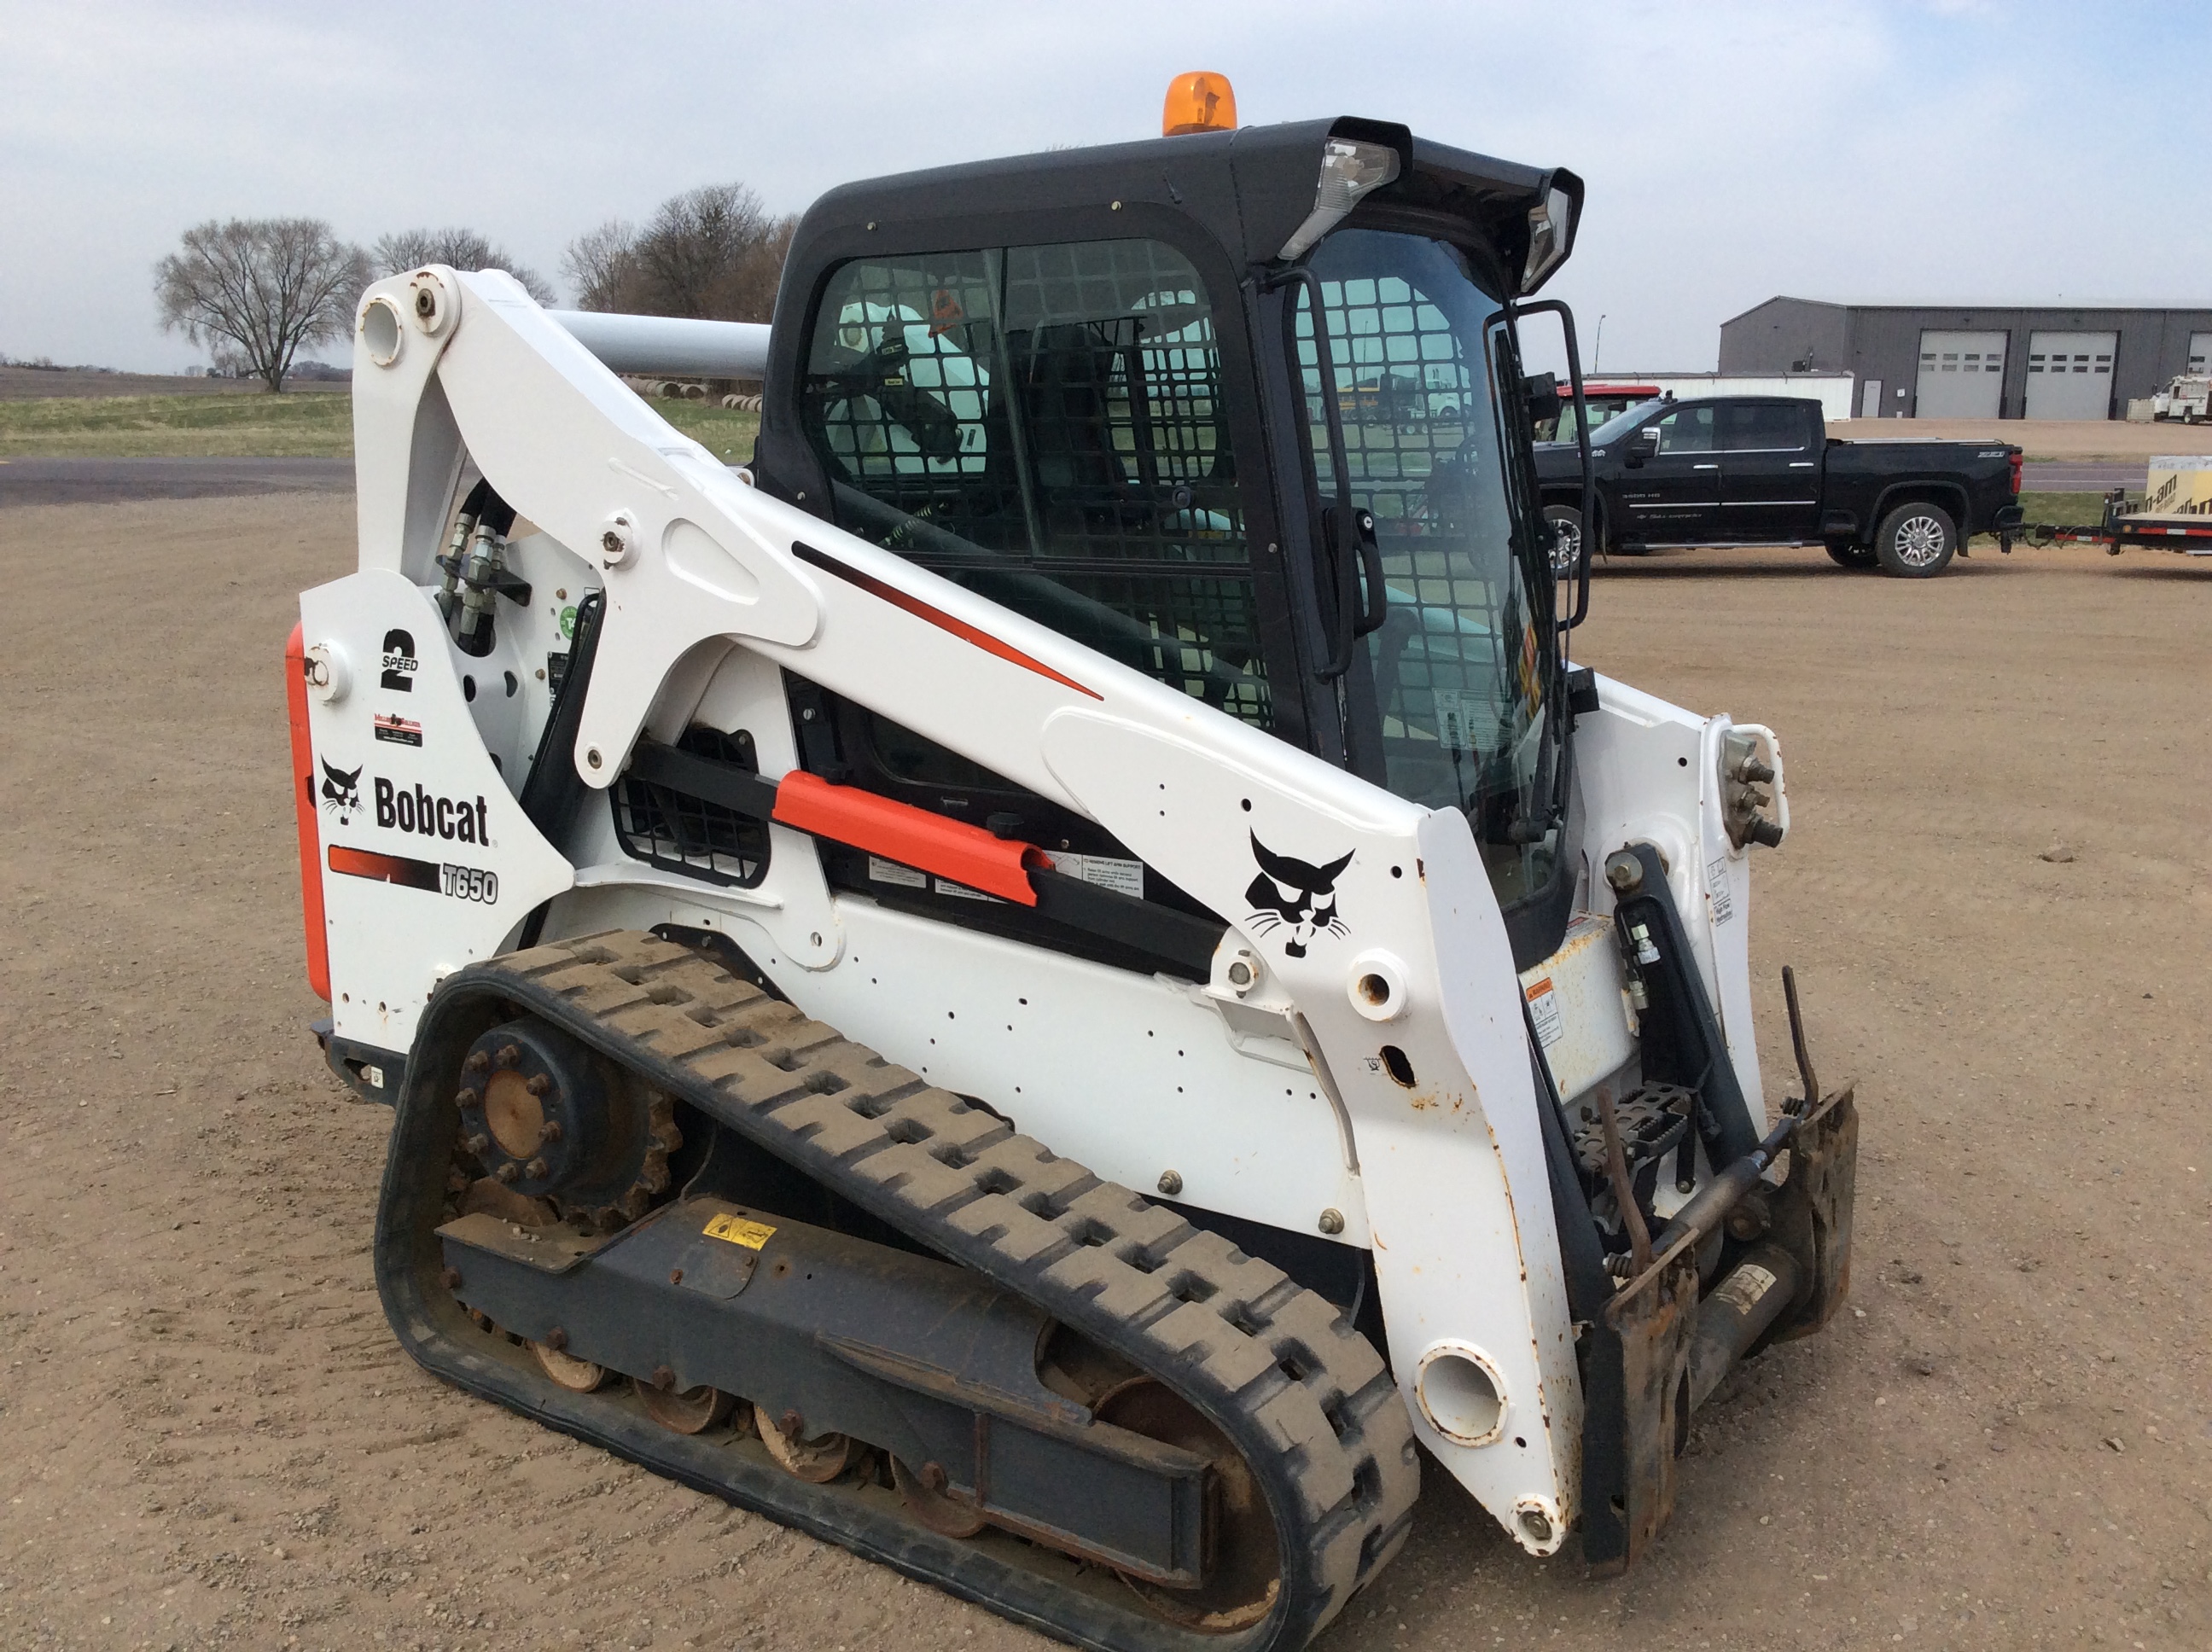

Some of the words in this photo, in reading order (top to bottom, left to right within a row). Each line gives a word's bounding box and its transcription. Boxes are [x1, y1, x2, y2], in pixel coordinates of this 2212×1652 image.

[381, 628, 416, 693] 2
[381, 654, 419, 672] SPEED
[374, 777, 489, 846] Bobcat
[443, 863, 498, 905] T650
